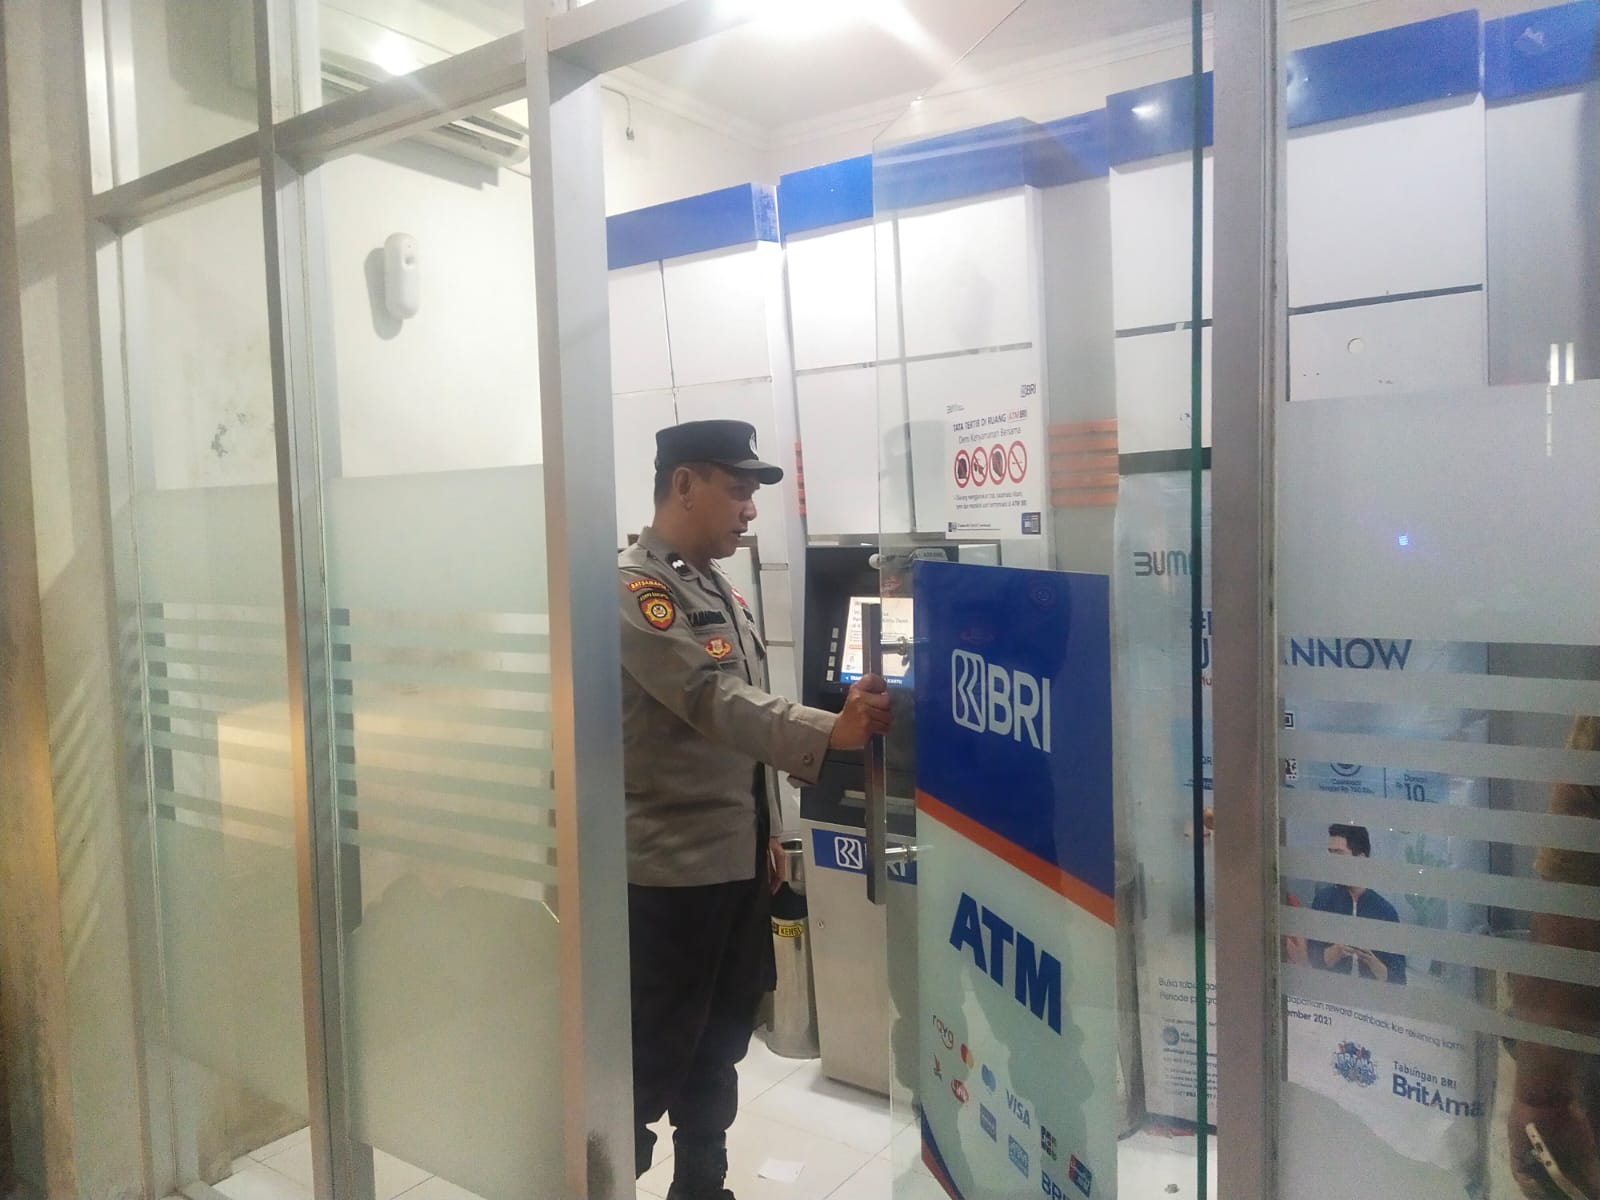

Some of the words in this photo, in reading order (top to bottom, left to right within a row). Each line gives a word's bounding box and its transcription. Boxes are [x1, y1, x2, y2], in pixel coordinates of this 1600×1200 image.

[988, 413, 1007, 425] RUANG
[1286, 637, 1413, 671] NNOW
[987, 662, 1052, 754] BRI
[949, 891, 1062, 1036] ATM
[1313, 1012, 1333, 1027] 2021
[1393, 1060, 1439, 1085] Tabungan
[1440, 1076, 1458, 1091] BRI
[1005, 1088, 1032, 1131] VISA
